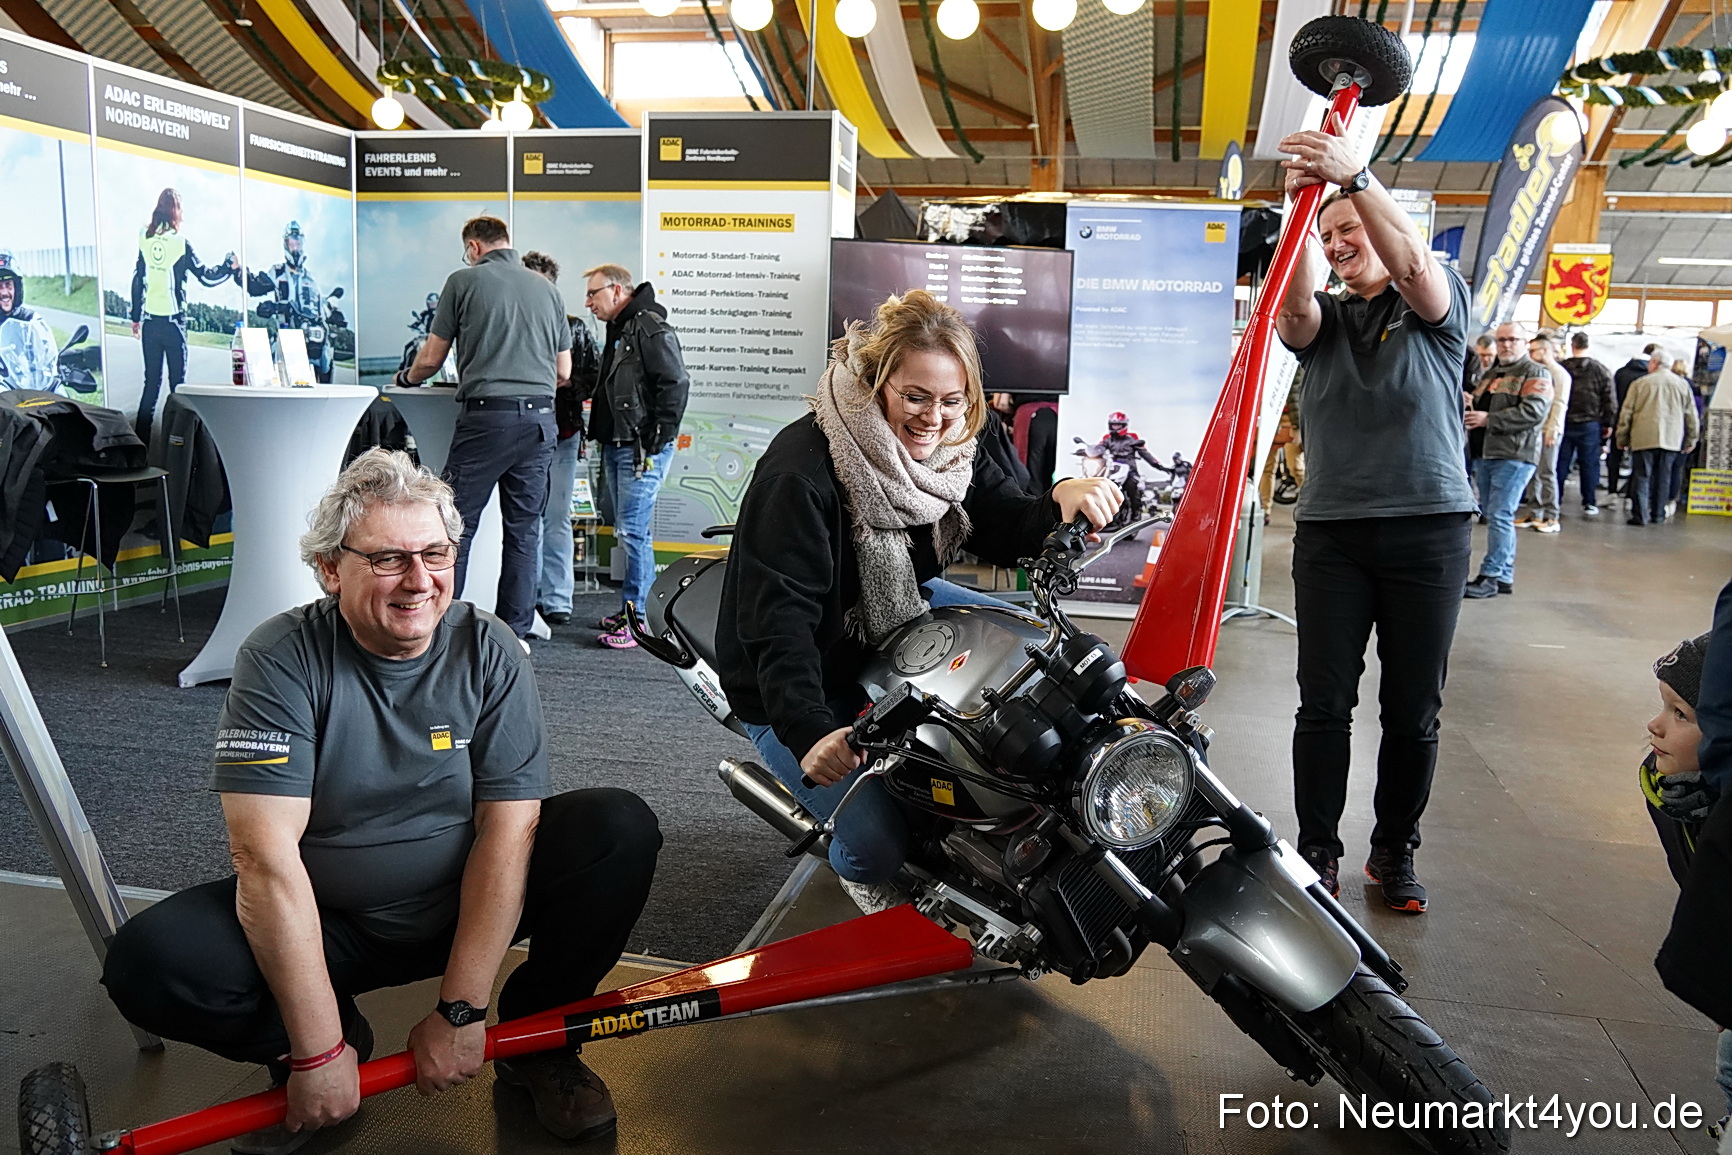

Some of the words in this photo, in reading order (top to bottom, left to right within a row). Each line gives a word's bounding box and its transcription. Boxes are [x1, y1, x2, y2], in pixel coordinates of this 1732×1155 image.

[104, 84, 140, 107] ADAC
[144, 94, 231, 131] ERLEBNISWELT
[105, 106, 190, 140] NORDBAYERN
[249, 133, 347, 168] FAHRSICHERHEITSTRAINING
[364, 152, 436, 163] FAHRERLEBNIS
[364, 166, 402, 177] EVENTS
[404, 166, 422, 176] und
[423, 167, 448, 177] mehr
[1520, 224, 1542, 266] größtes
[1536, 153, 1574, 228] Zweirad-Center
[662, 216, 792, 229] MOTORRAD-TRAININGS
[672, 252, 780, 262] Motorrad-Standard-Training
[696, 271, 801, 281] Motorrad-Intensiv-Training
[1076, 278, 1099, 290] DIE
[1102, 279, 1138, 290] BMW
[1142, 280, 1223, 294] MOTORRAD
[671, 289, 788, 300] Motorrad-Perfektions-Training
[671, 308, 792, 318] Motorrad-Schräglagen-Training
[772, 347, 794, 355] Basis
[772, 366, 806, 375] Kompakt
[744, 382, 781, 390] Umgebung
[1080, 657, 1091, 669] MOT
[692, 683, 719, 712] SPEER
[218, 728, 292, 742] ERLEBNISWELT
[229, 741, 290, 753] NORDBAYERN
[931, 780, 952, 791] ADAC
